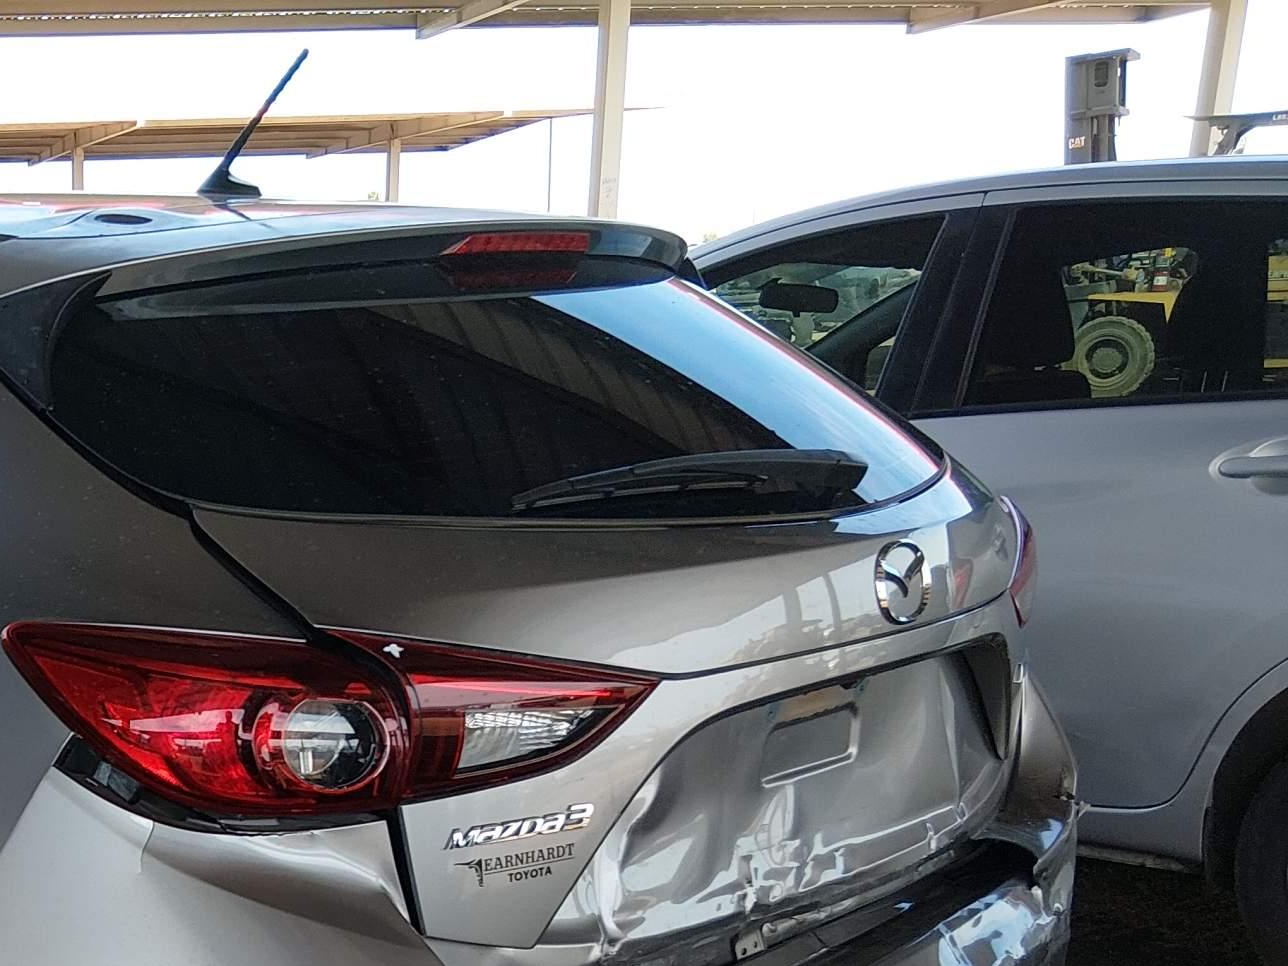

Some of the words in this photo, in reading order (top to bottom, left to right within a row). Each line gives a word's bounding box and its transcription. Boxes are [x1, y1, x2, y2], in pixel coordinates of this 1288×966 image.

[1068, 136, 1086, 149] CAT
[484, 843, 575, 872] EARNHARDT
[508, 866, 552, 882] TOYOTA
